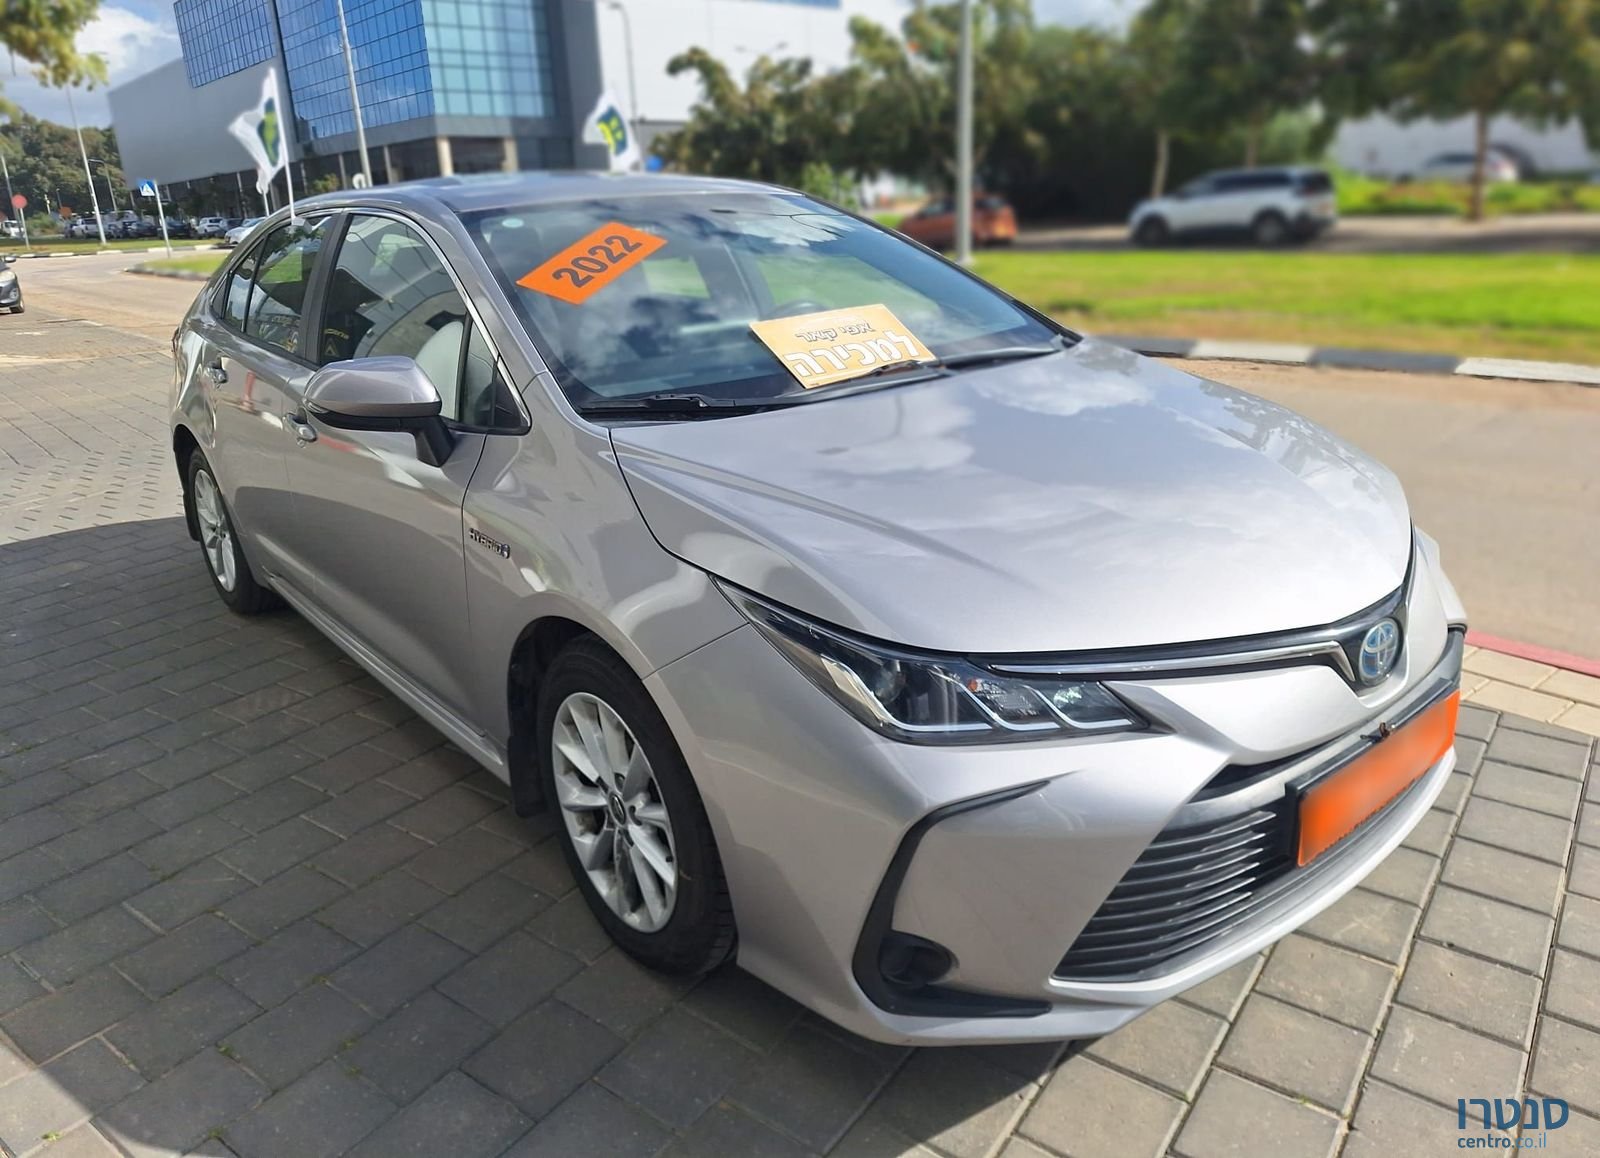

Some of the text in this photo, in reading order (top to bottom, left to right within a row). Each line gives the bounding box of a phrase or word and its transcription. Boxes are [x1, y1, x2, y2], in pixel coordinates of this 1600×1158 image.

[552, 235, 642, 288] 2022
[784, 330, 920, 377] למכירה
[469, 527, 502, 555] HYBRID
